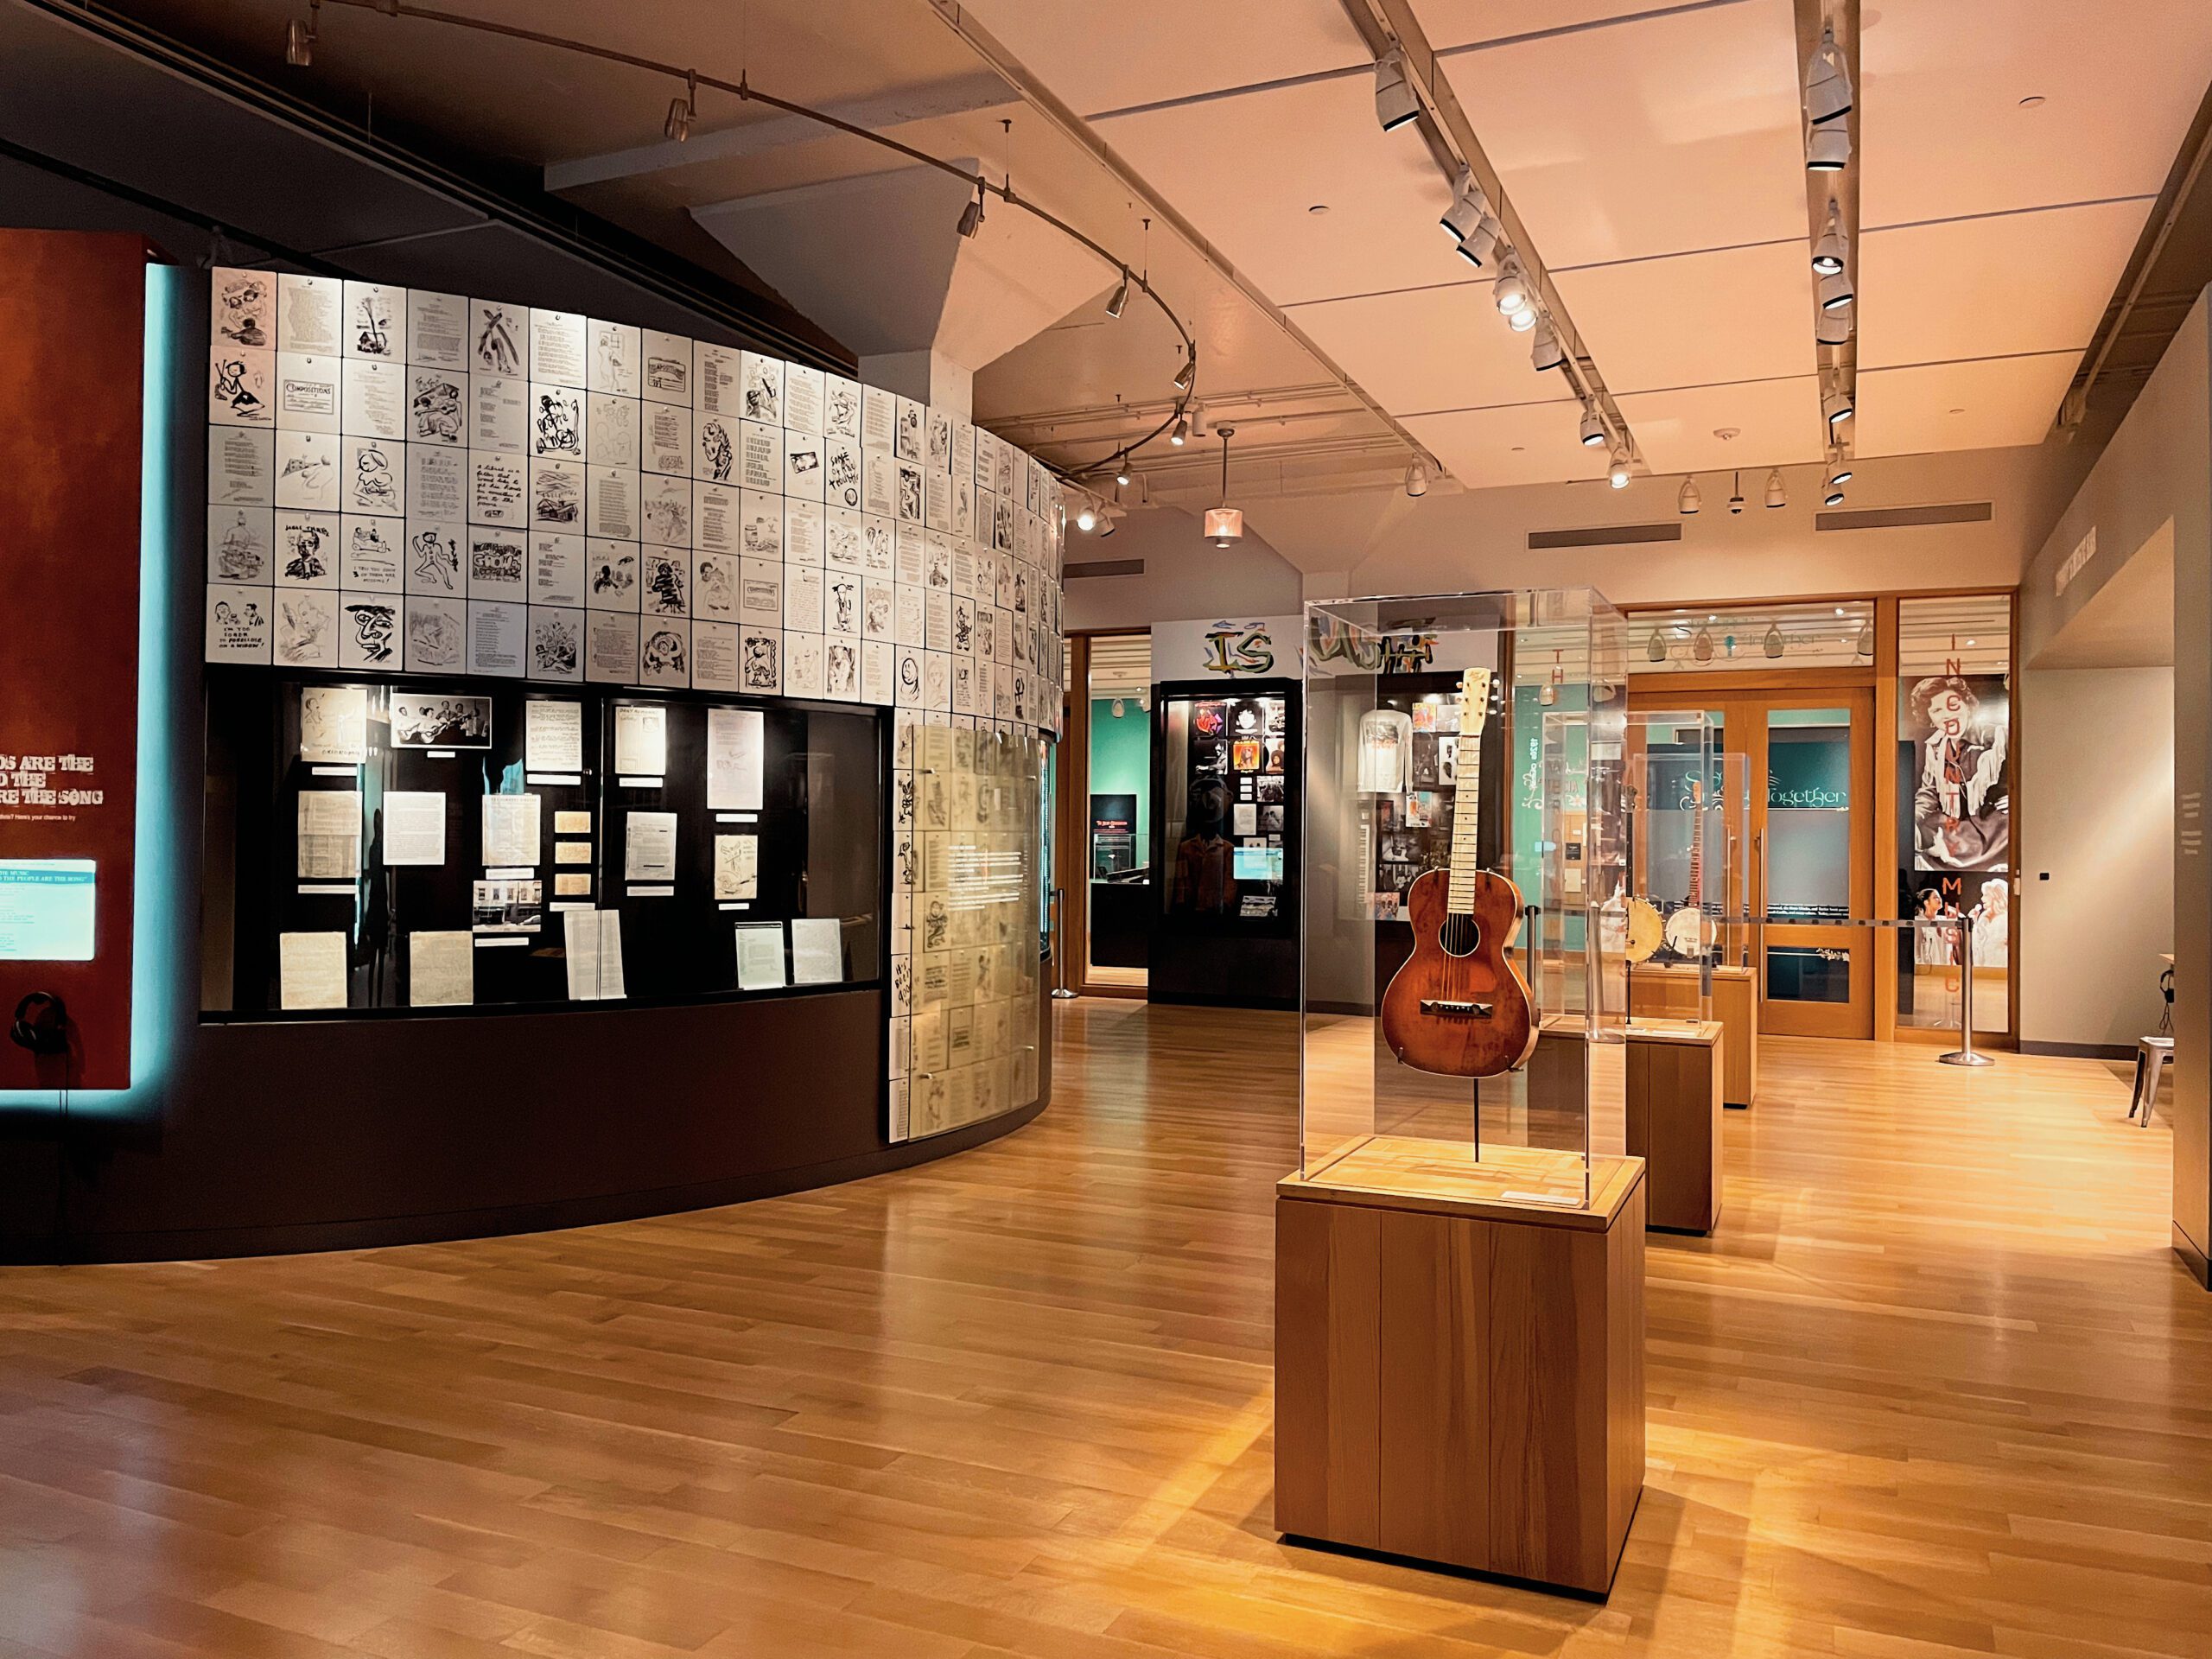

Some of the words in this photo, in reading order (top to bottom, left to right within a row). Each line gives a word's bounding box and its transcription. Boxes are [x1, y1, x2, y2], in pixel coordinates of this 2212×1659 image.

[19, 756, 55, 772] ARE
[58, 753, 94, 772] THE
[10, 769, 47, 788] THE
[21, 785, 56, 805] THE
[58, 788, 104, 806] SONG
[1942, 877, 1961, 992] MUSIC
